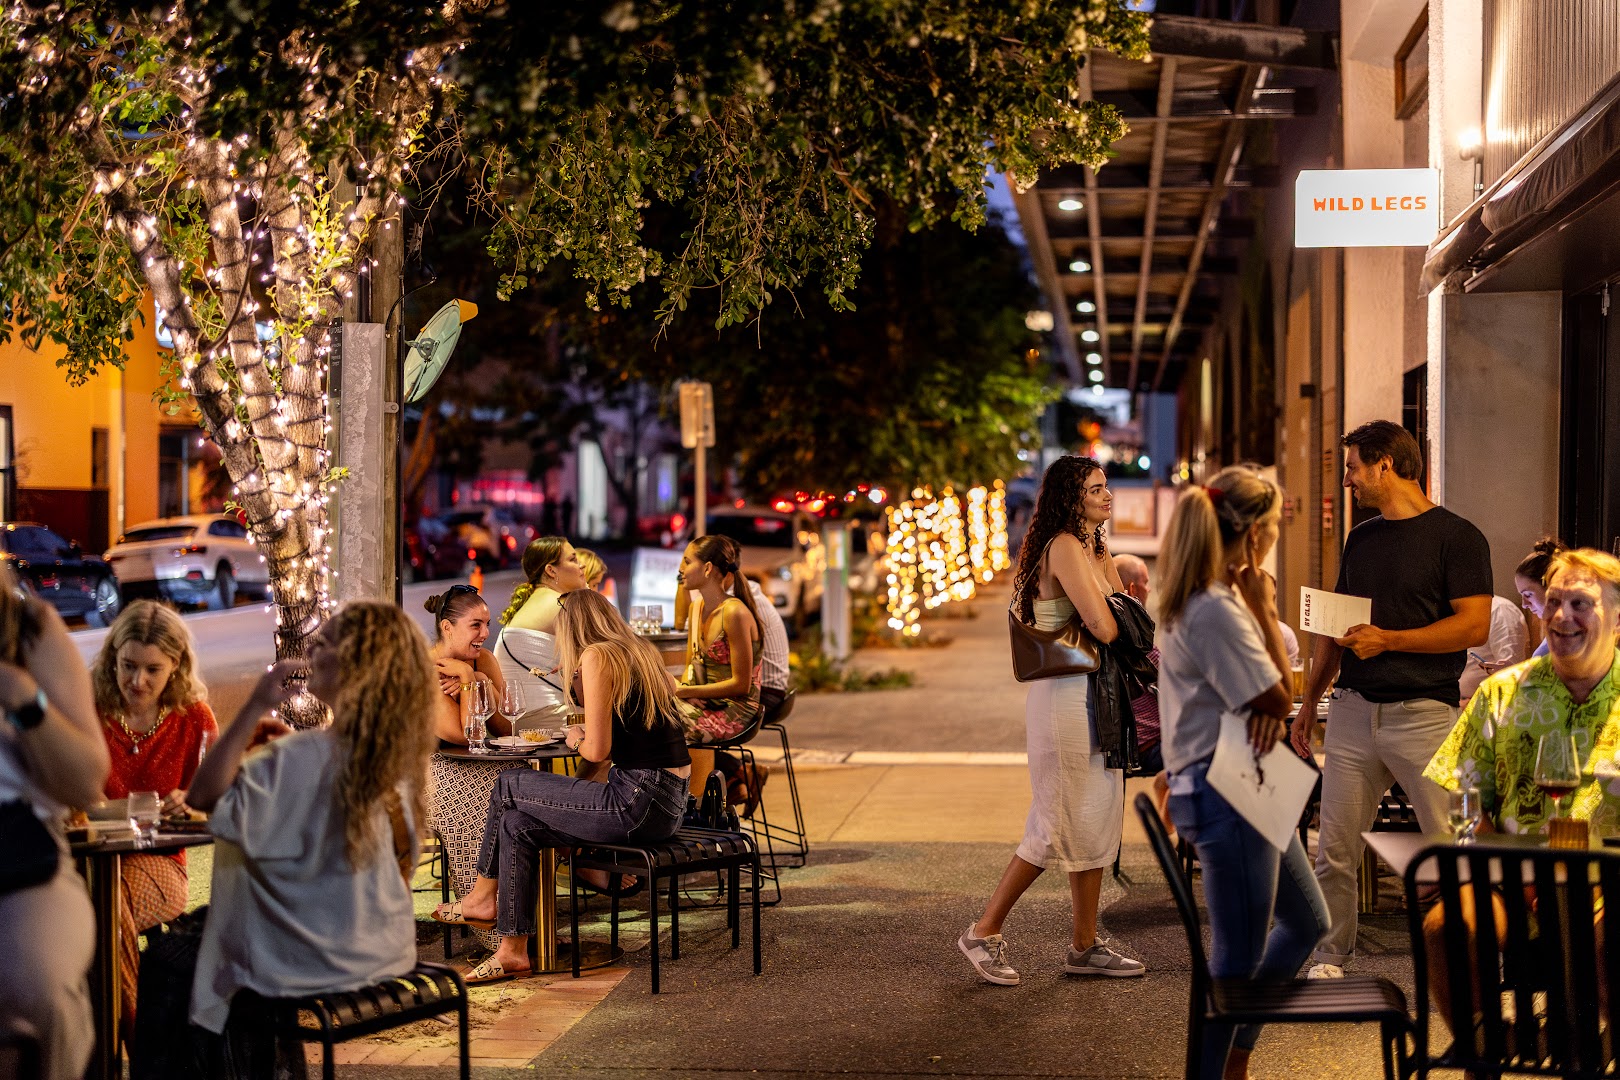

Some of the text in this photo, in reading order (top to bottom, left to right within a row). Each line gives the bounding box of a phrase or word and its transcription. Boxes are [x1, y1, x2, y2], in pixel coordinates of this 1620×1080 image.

[1313, 196, 1427, 211] WILD LEGS
[1304, 617, 1311, 627] BY
